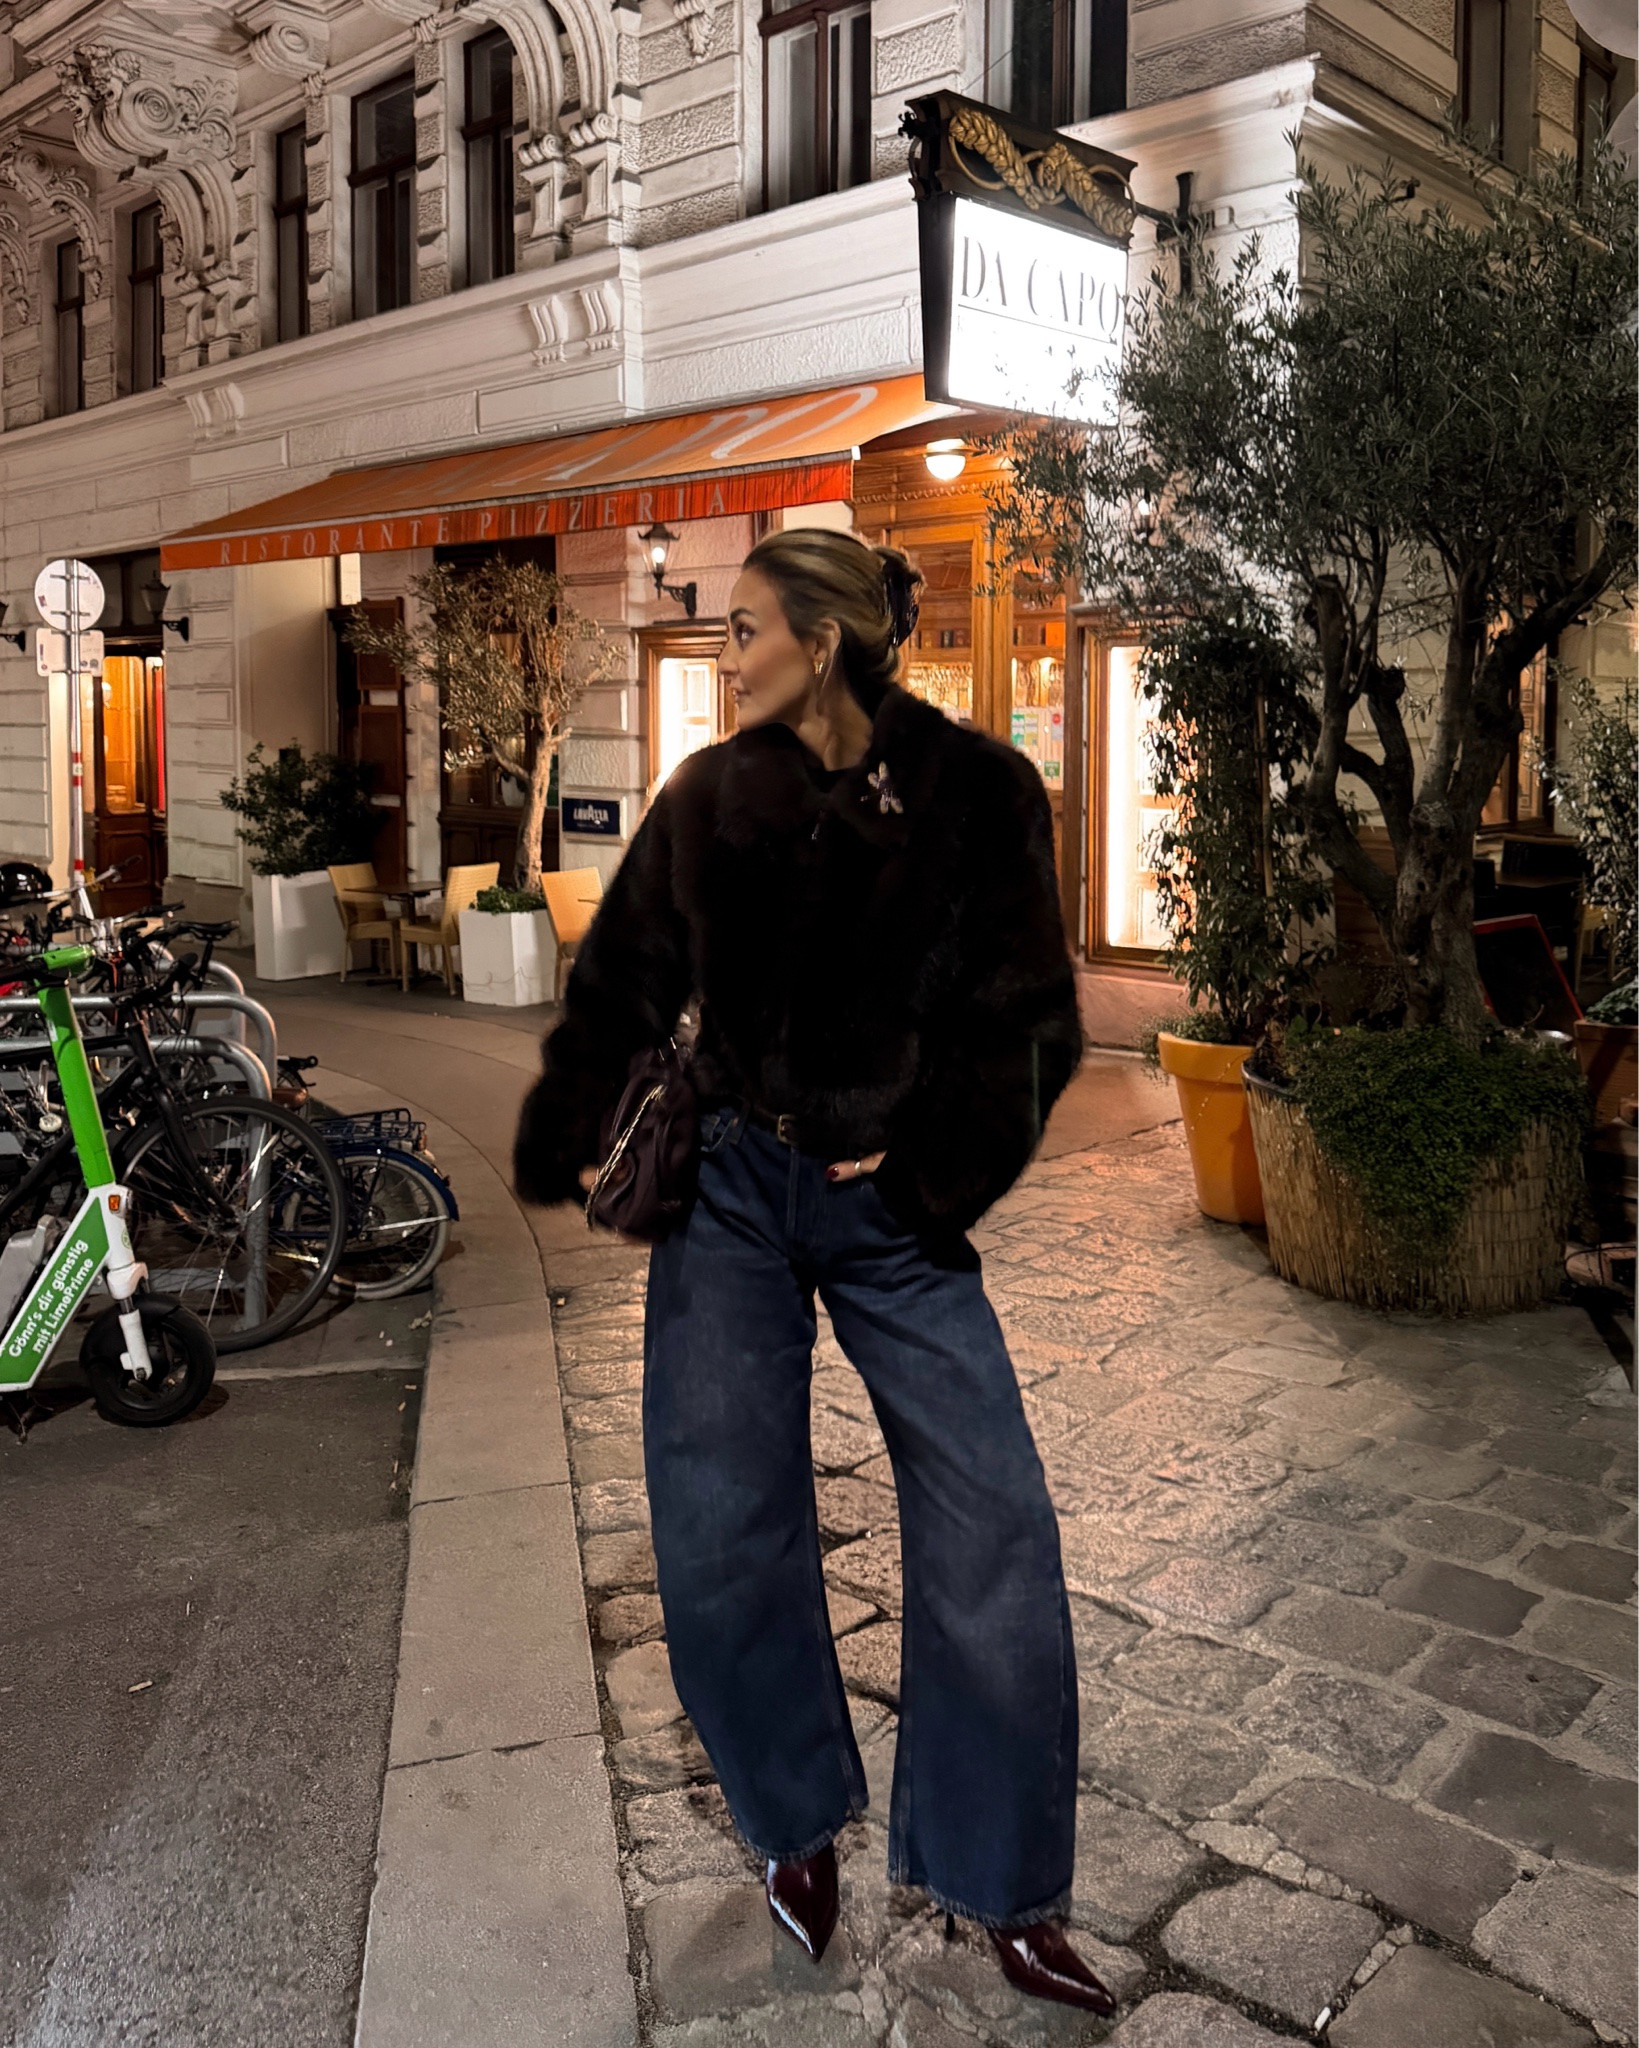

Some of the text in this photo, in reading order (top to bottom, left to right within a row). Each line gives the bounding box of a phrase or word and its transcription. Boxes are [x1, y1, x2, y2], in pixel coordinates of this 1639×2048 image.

[960, 235, 1121, 335] DA CAPO
[220, 483, 726, 566] RISTORANTE PIZZERIA
[9, 1239, 89, 1357] Gönn's dir günstig
[32, 1258, 94, 1354] mit LimoPrime
